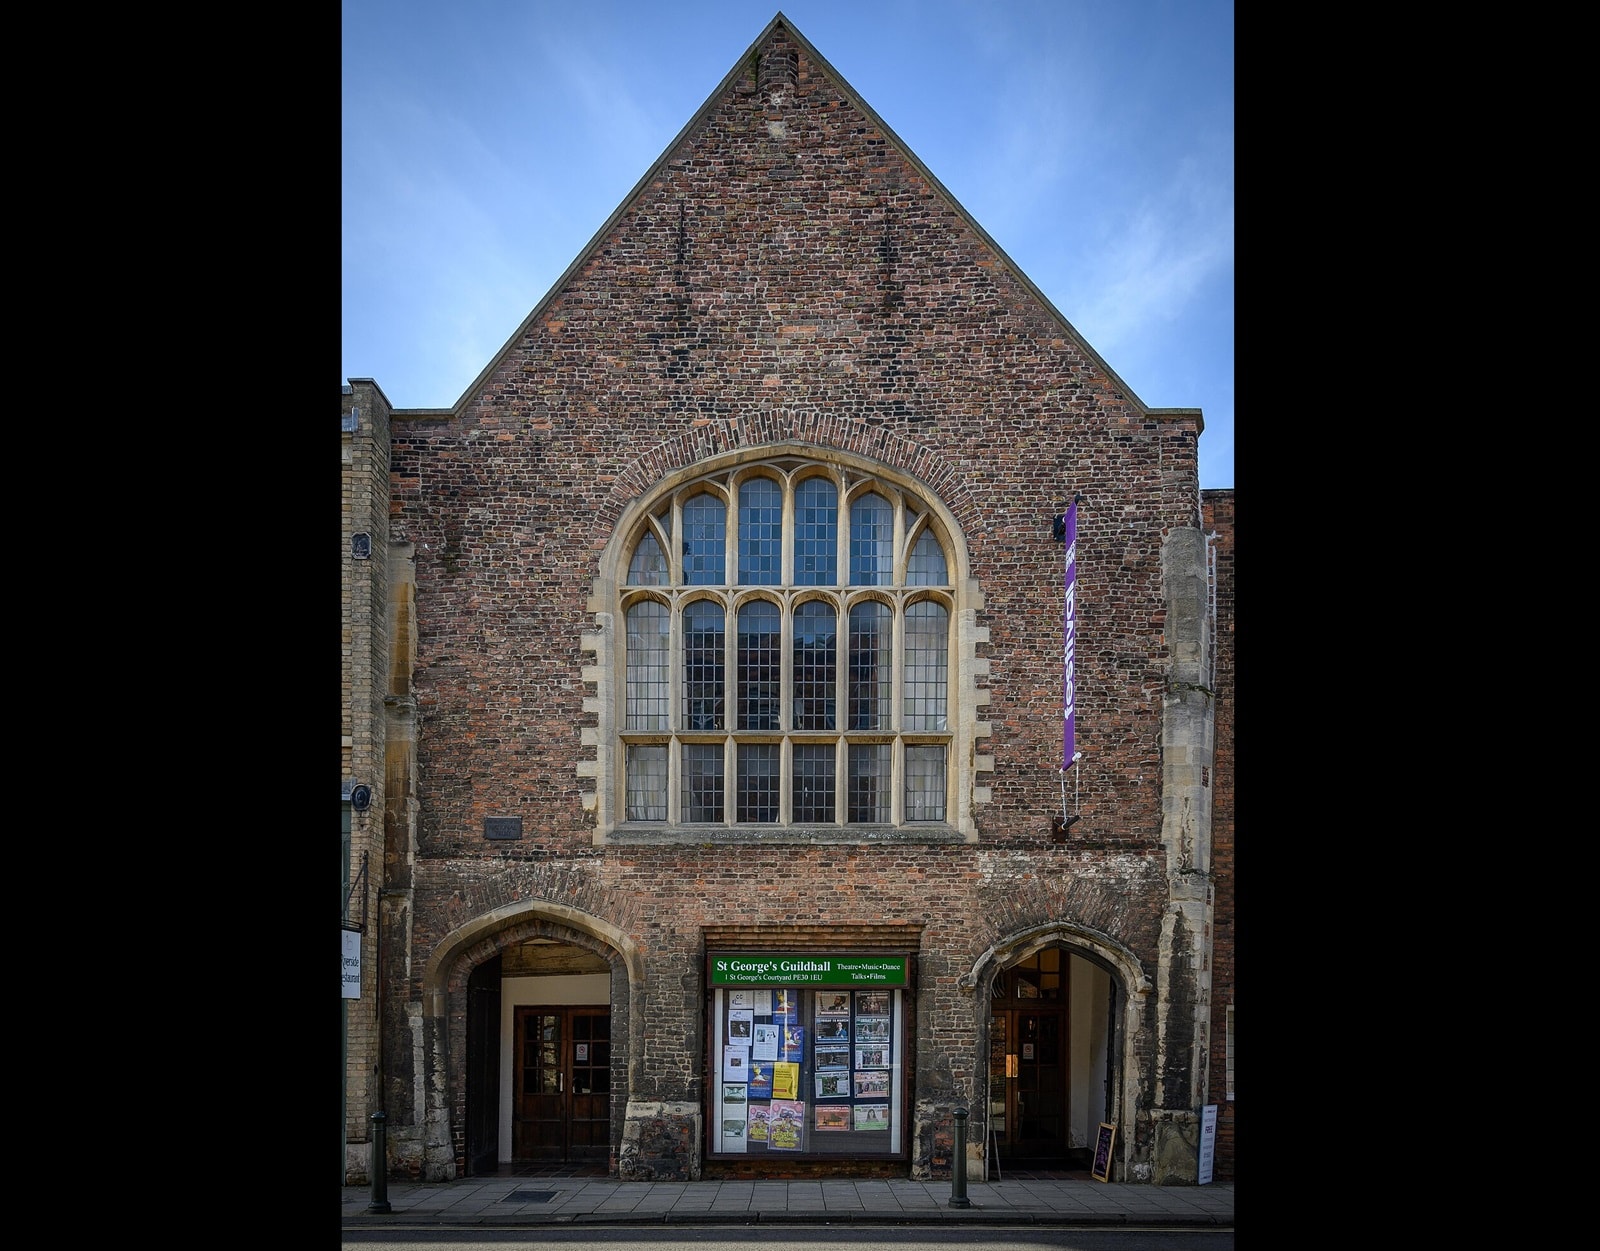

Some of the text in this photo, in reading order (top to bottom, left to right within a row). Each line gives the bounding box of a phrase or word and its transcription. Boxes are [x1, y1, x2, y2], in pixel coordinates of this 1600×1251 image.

[1064, 580, 1075, 720] festival
[717, 960, 831, 974] St George's Guildhall
[736, 974, 762, 983] George's
[762, 974, 792, 983] Courtyard
